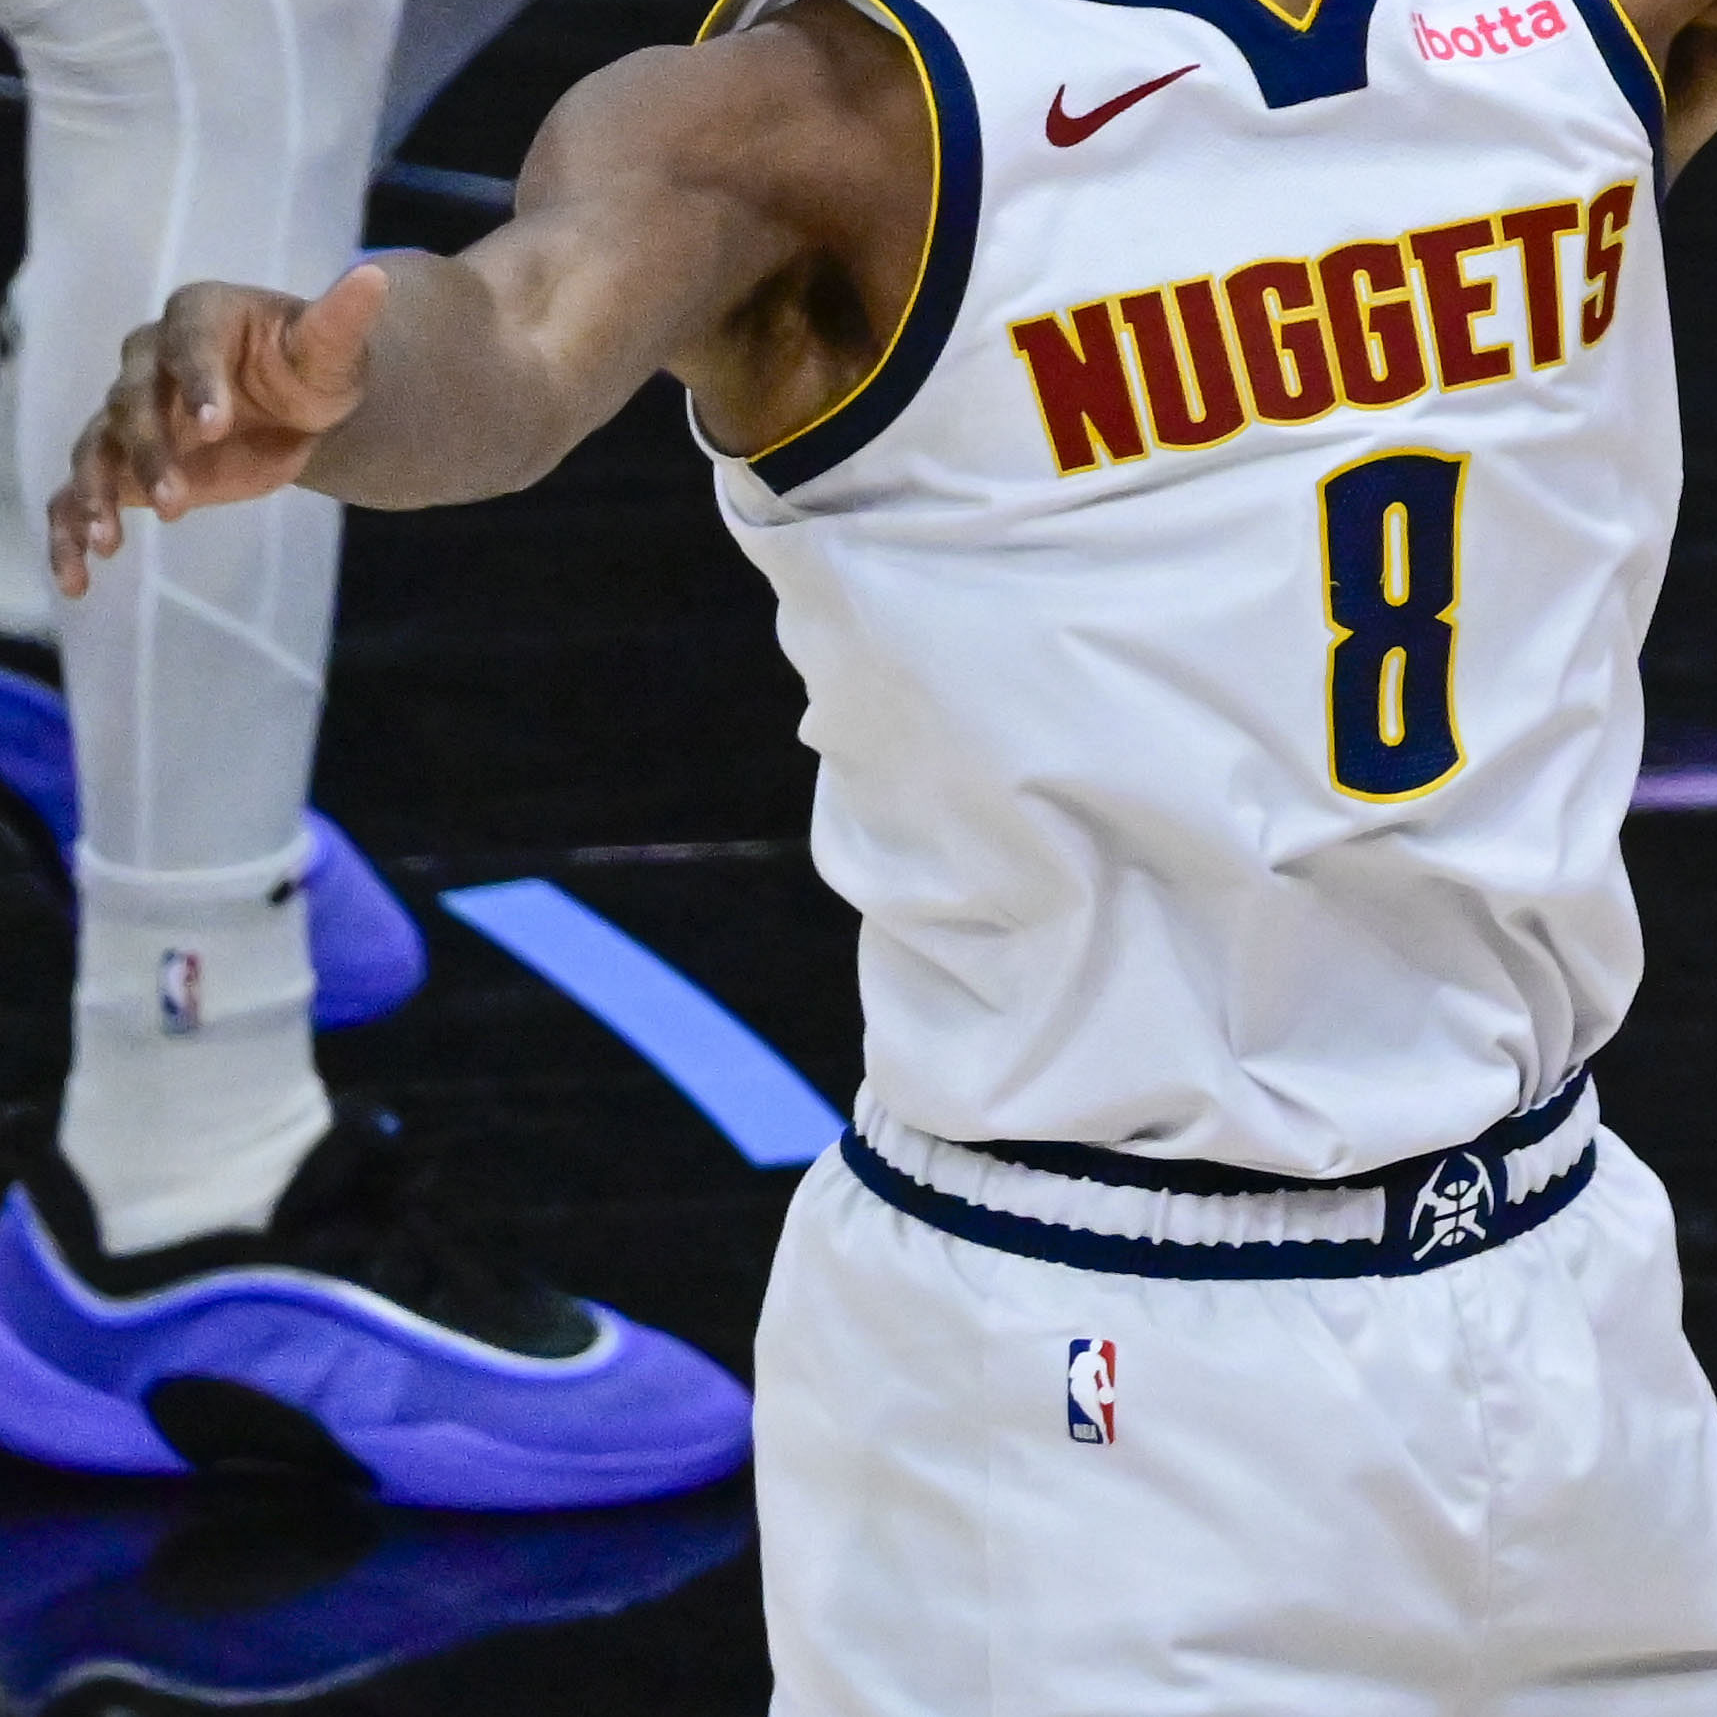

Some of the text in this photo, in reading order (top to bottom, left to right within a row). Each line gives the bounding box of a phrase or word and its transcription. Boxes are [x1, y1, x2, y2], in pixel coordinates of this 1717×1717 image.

[1411, 0, 1568, 61] ibotta
[1006, 176, 1639, 479] NUGGETS
[1317, 445, 1472, 804] 8
